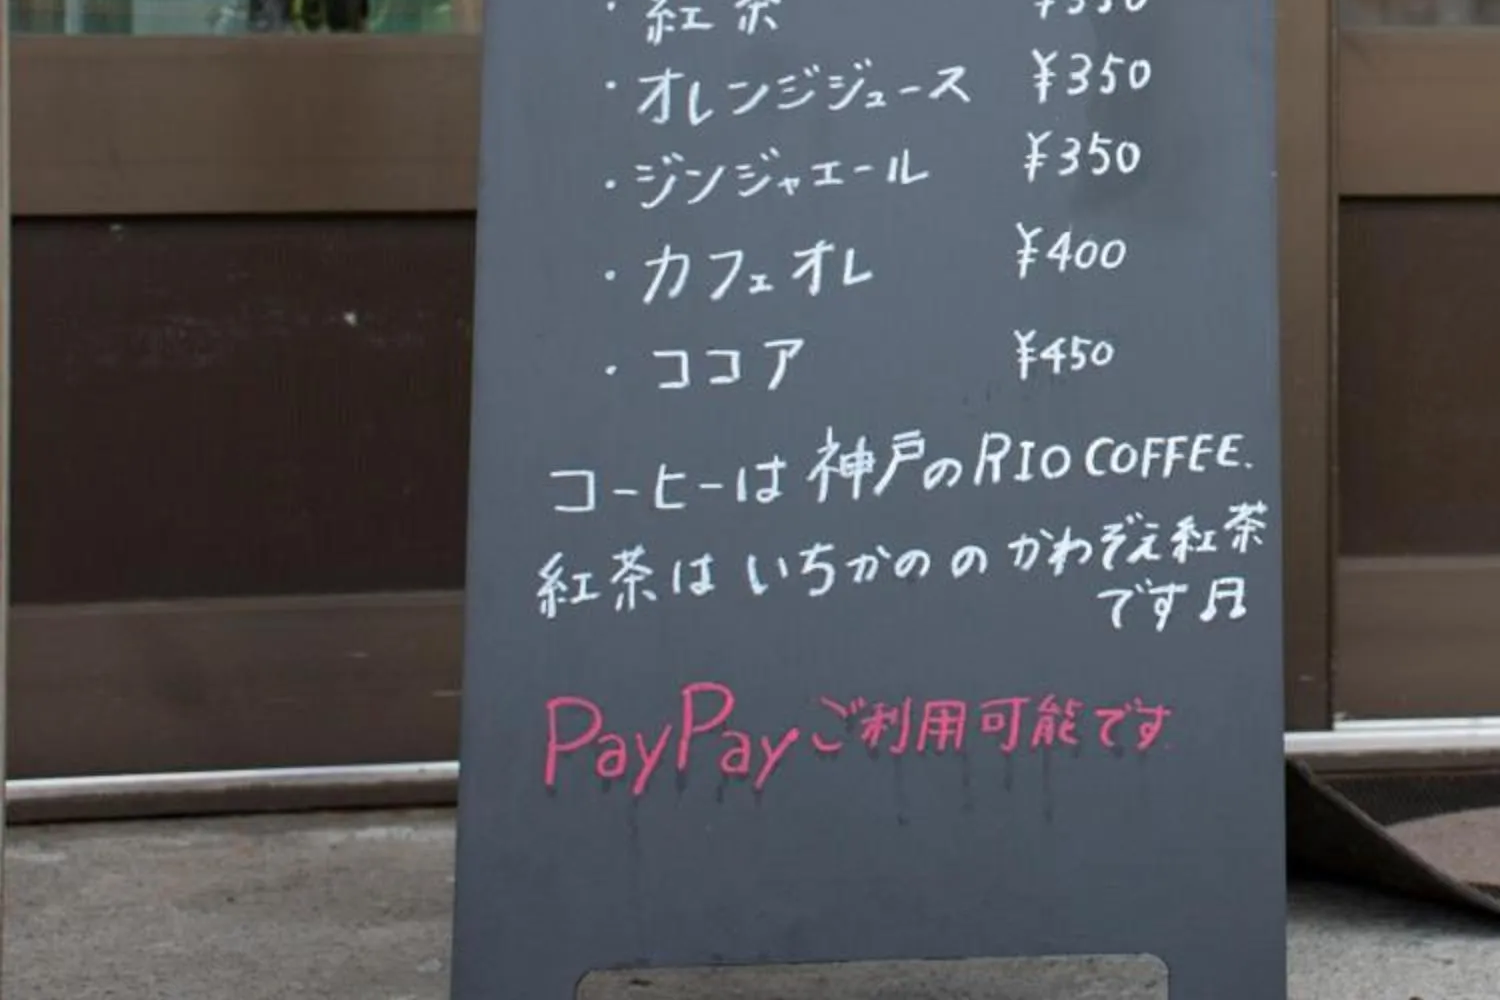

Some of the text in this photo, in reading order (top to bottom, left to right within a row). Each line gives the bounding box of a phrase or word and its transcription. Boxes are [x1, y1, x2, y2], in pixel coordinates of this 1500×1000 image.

[637, 48, 1152, 126] オレンジジュース ¥350
[635, 130, 1141, 210] ジンジャエール ¥350
[642, 221, 1127, 305] カフェオレ ¥400
[652, 329, 1115, 391] ココア ¥450
[542, 681, 1169, 794] PayPay ご利用可能です
